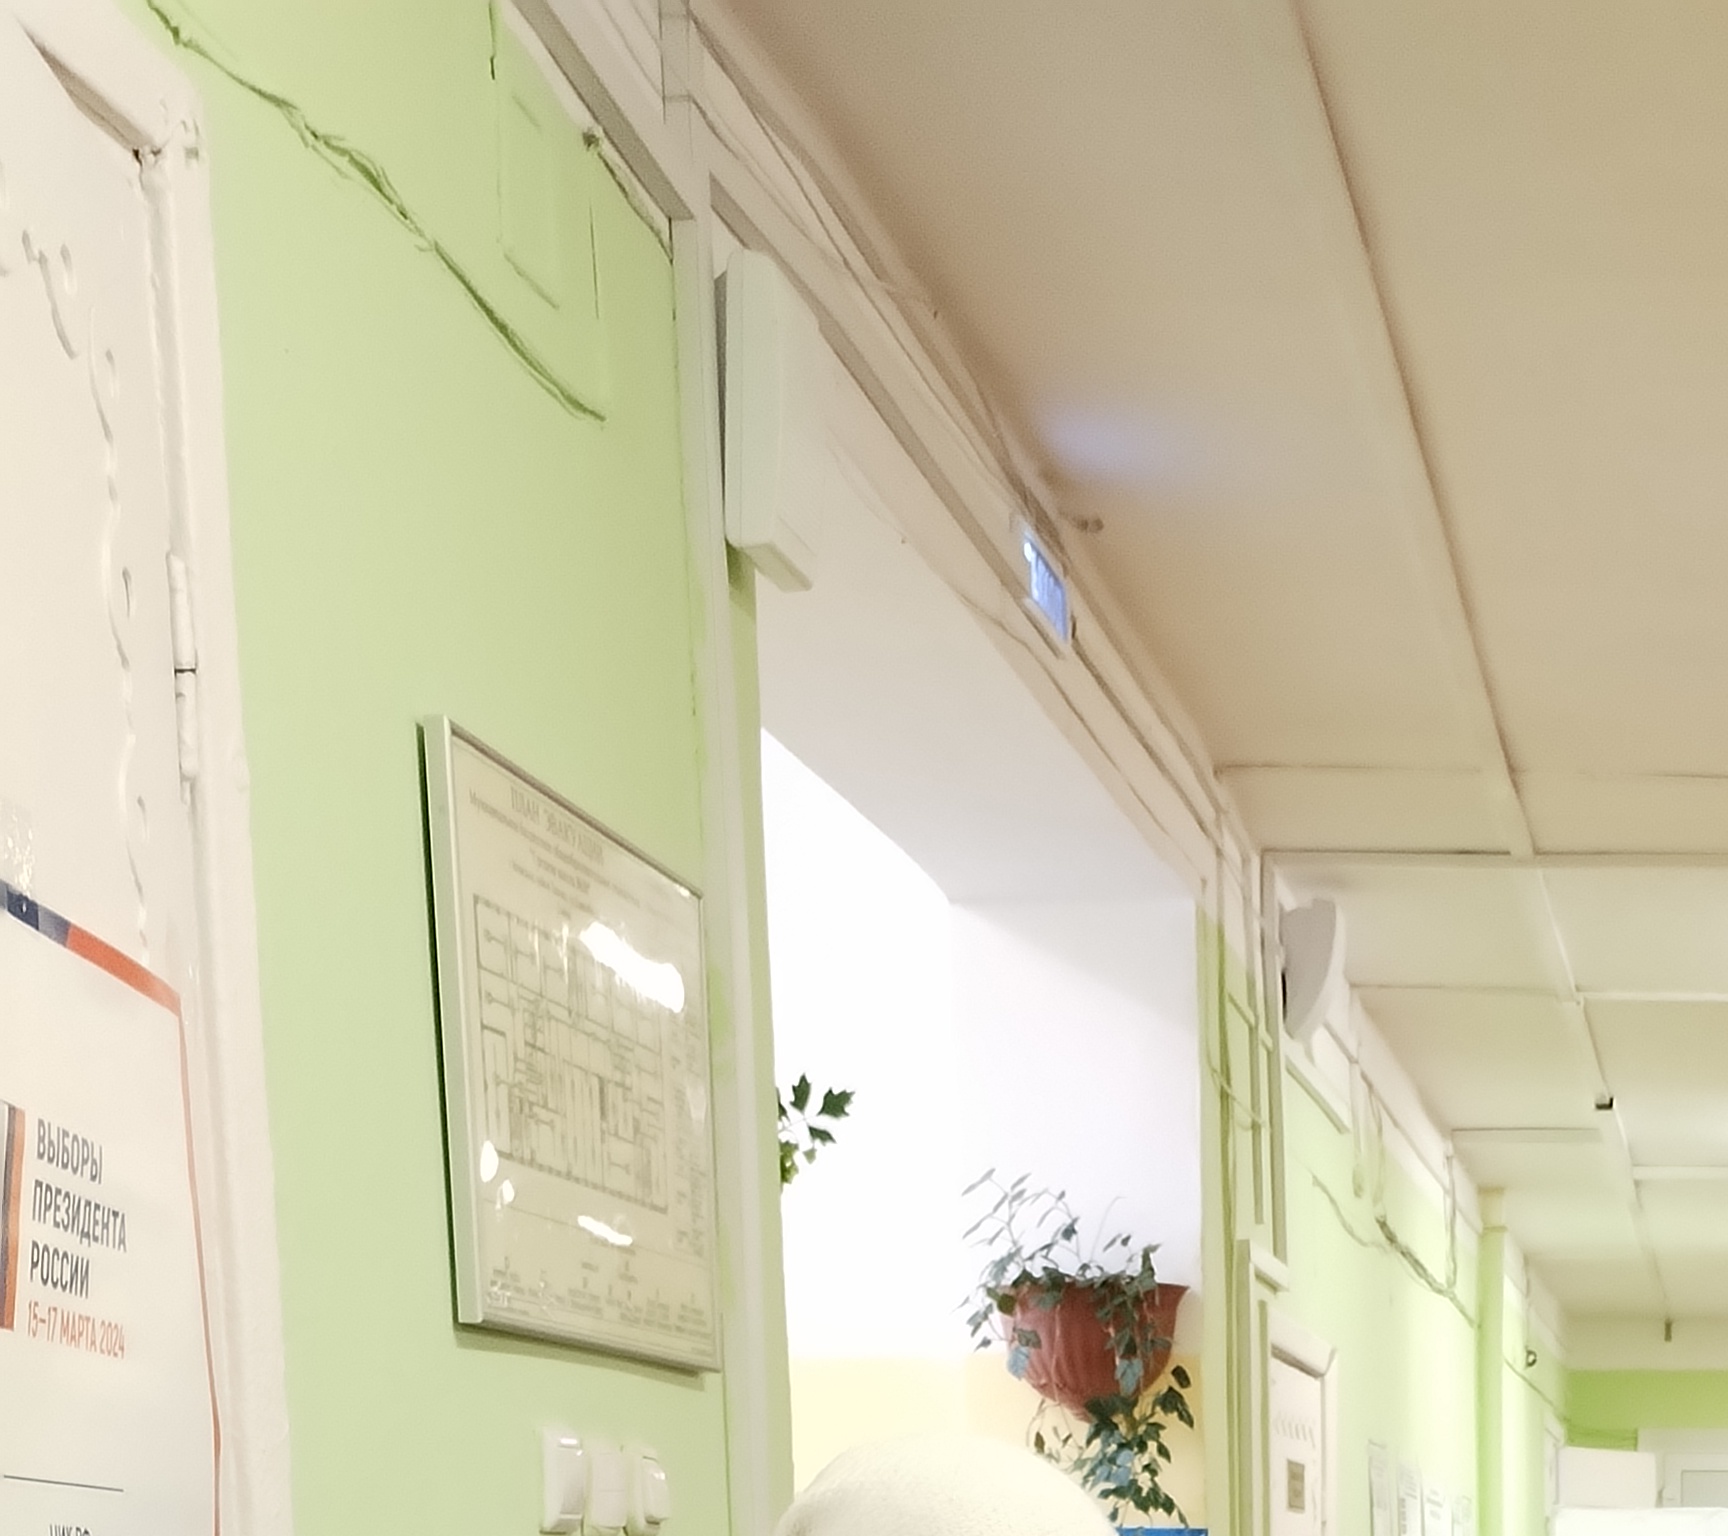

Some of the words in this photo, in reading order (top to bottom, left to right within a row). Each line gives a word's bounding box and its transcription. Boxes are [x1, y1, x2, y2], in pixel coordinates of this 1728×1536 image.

[36, 1117, 103, 1185] ВЫБОРЫ
[32, 1178, 127, 1253] ПРЕЗИДЕНТА
[30, 1239, 90, 1299] РОССИИ
[59, 1308, 98, 1354] МАРТА
[99, 1319, 126, 1360] 2024
